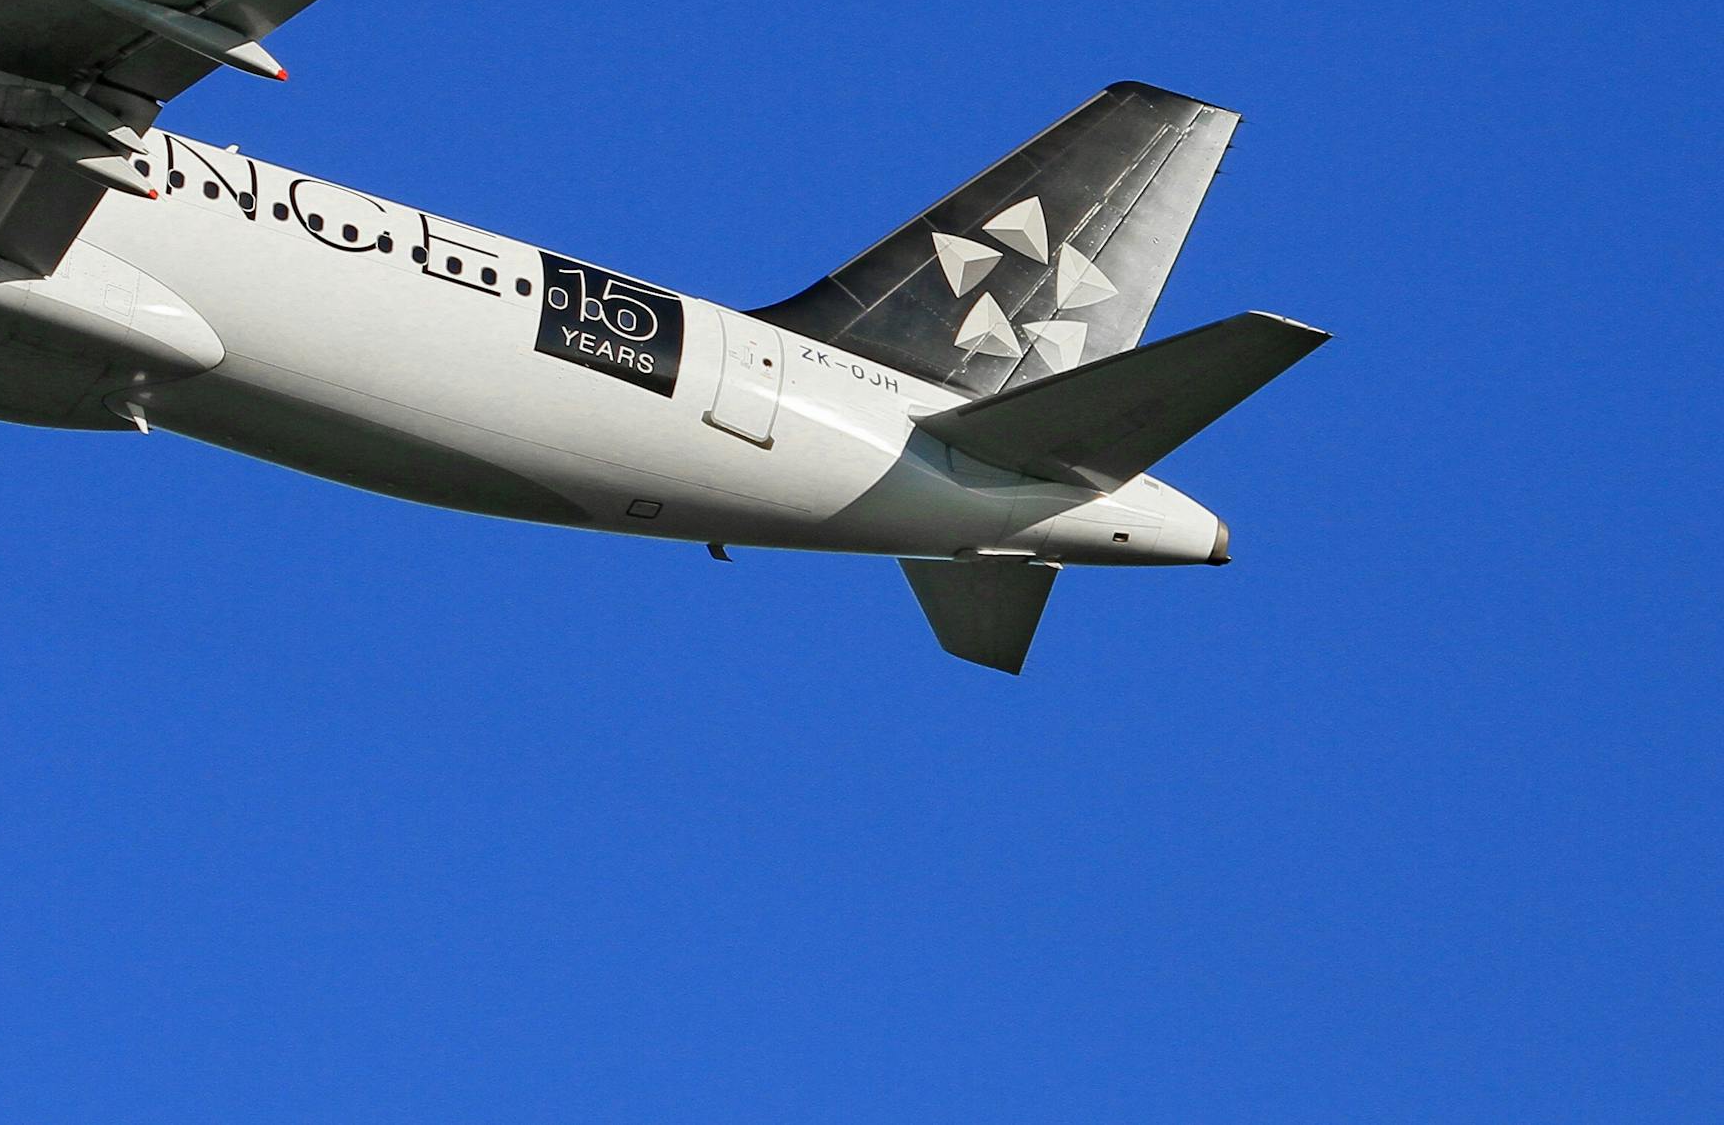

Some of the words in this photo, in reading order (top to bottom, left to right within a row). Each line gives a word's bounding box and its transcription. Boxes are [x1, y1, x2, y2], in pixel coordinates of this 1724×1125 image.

[558, 268, 682, 342] 15
[561, 325, 656, 375] YEARS
[799, 344, 899, 394] ZK-OJH
